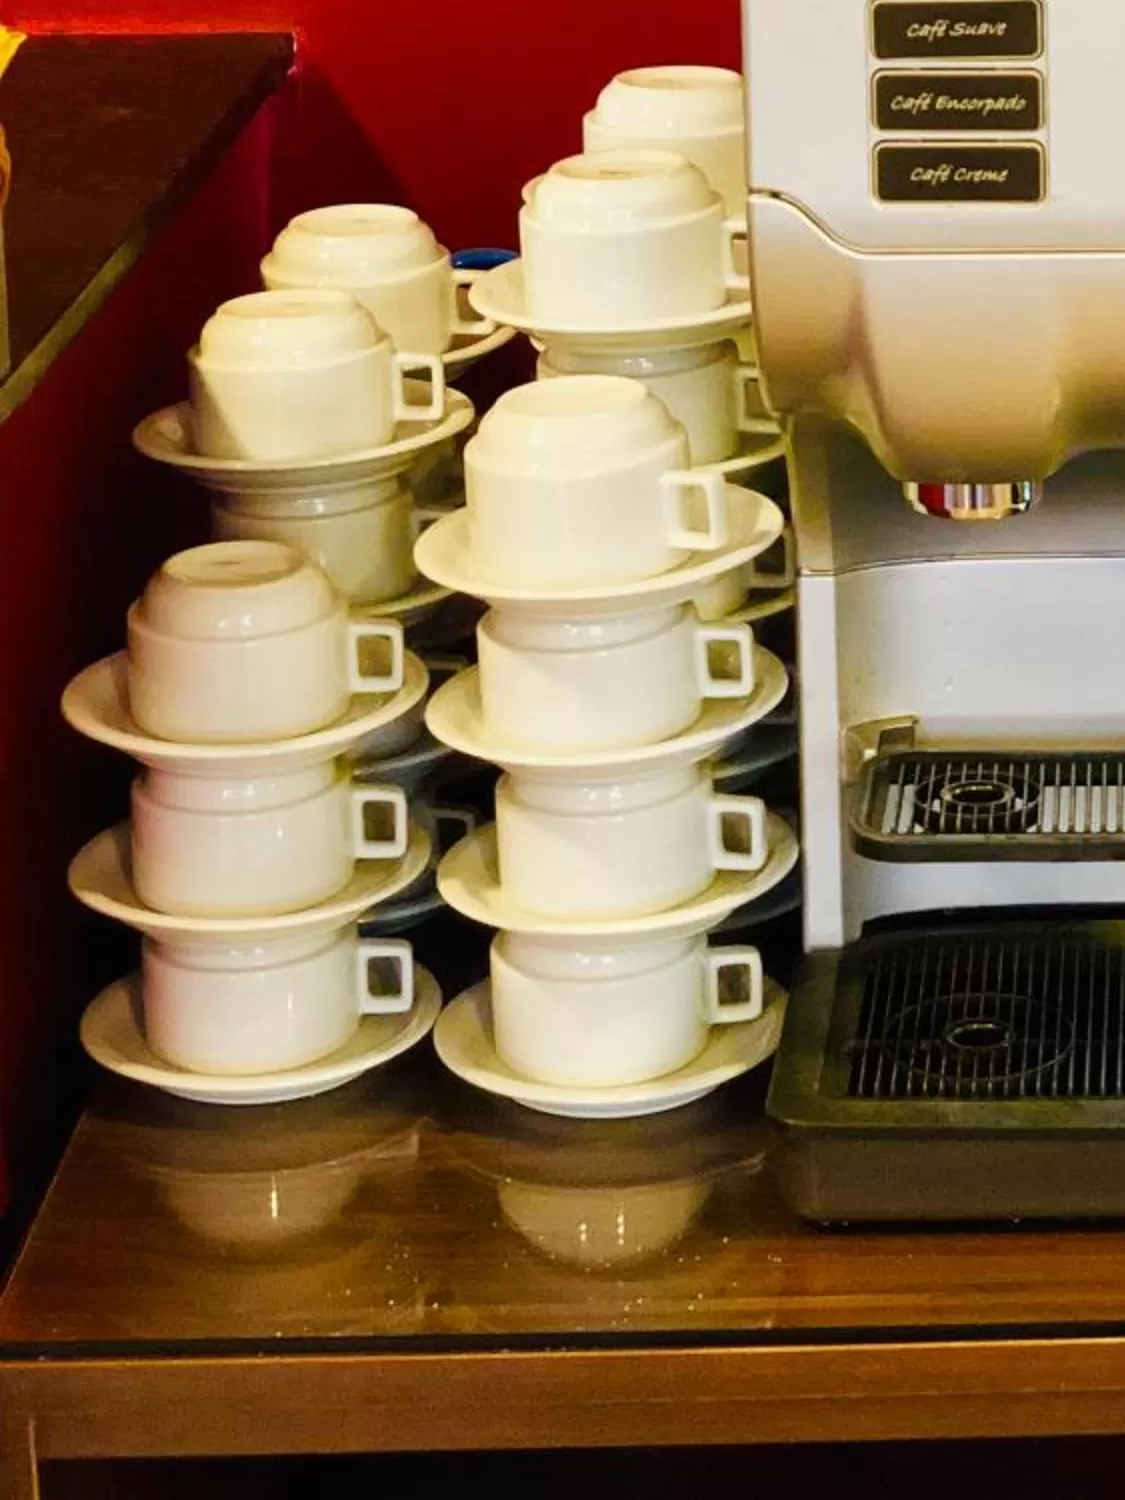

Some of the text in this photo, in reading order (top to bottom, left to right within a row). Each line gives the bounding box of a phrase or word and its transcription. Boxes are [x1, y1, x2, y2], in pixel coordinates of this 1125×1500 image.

[906, 19, 1008, 42] Café Suave
[890, 92, 1027, 117] Café Encorpado
[909, 164, 1009, 187] Café Creme
